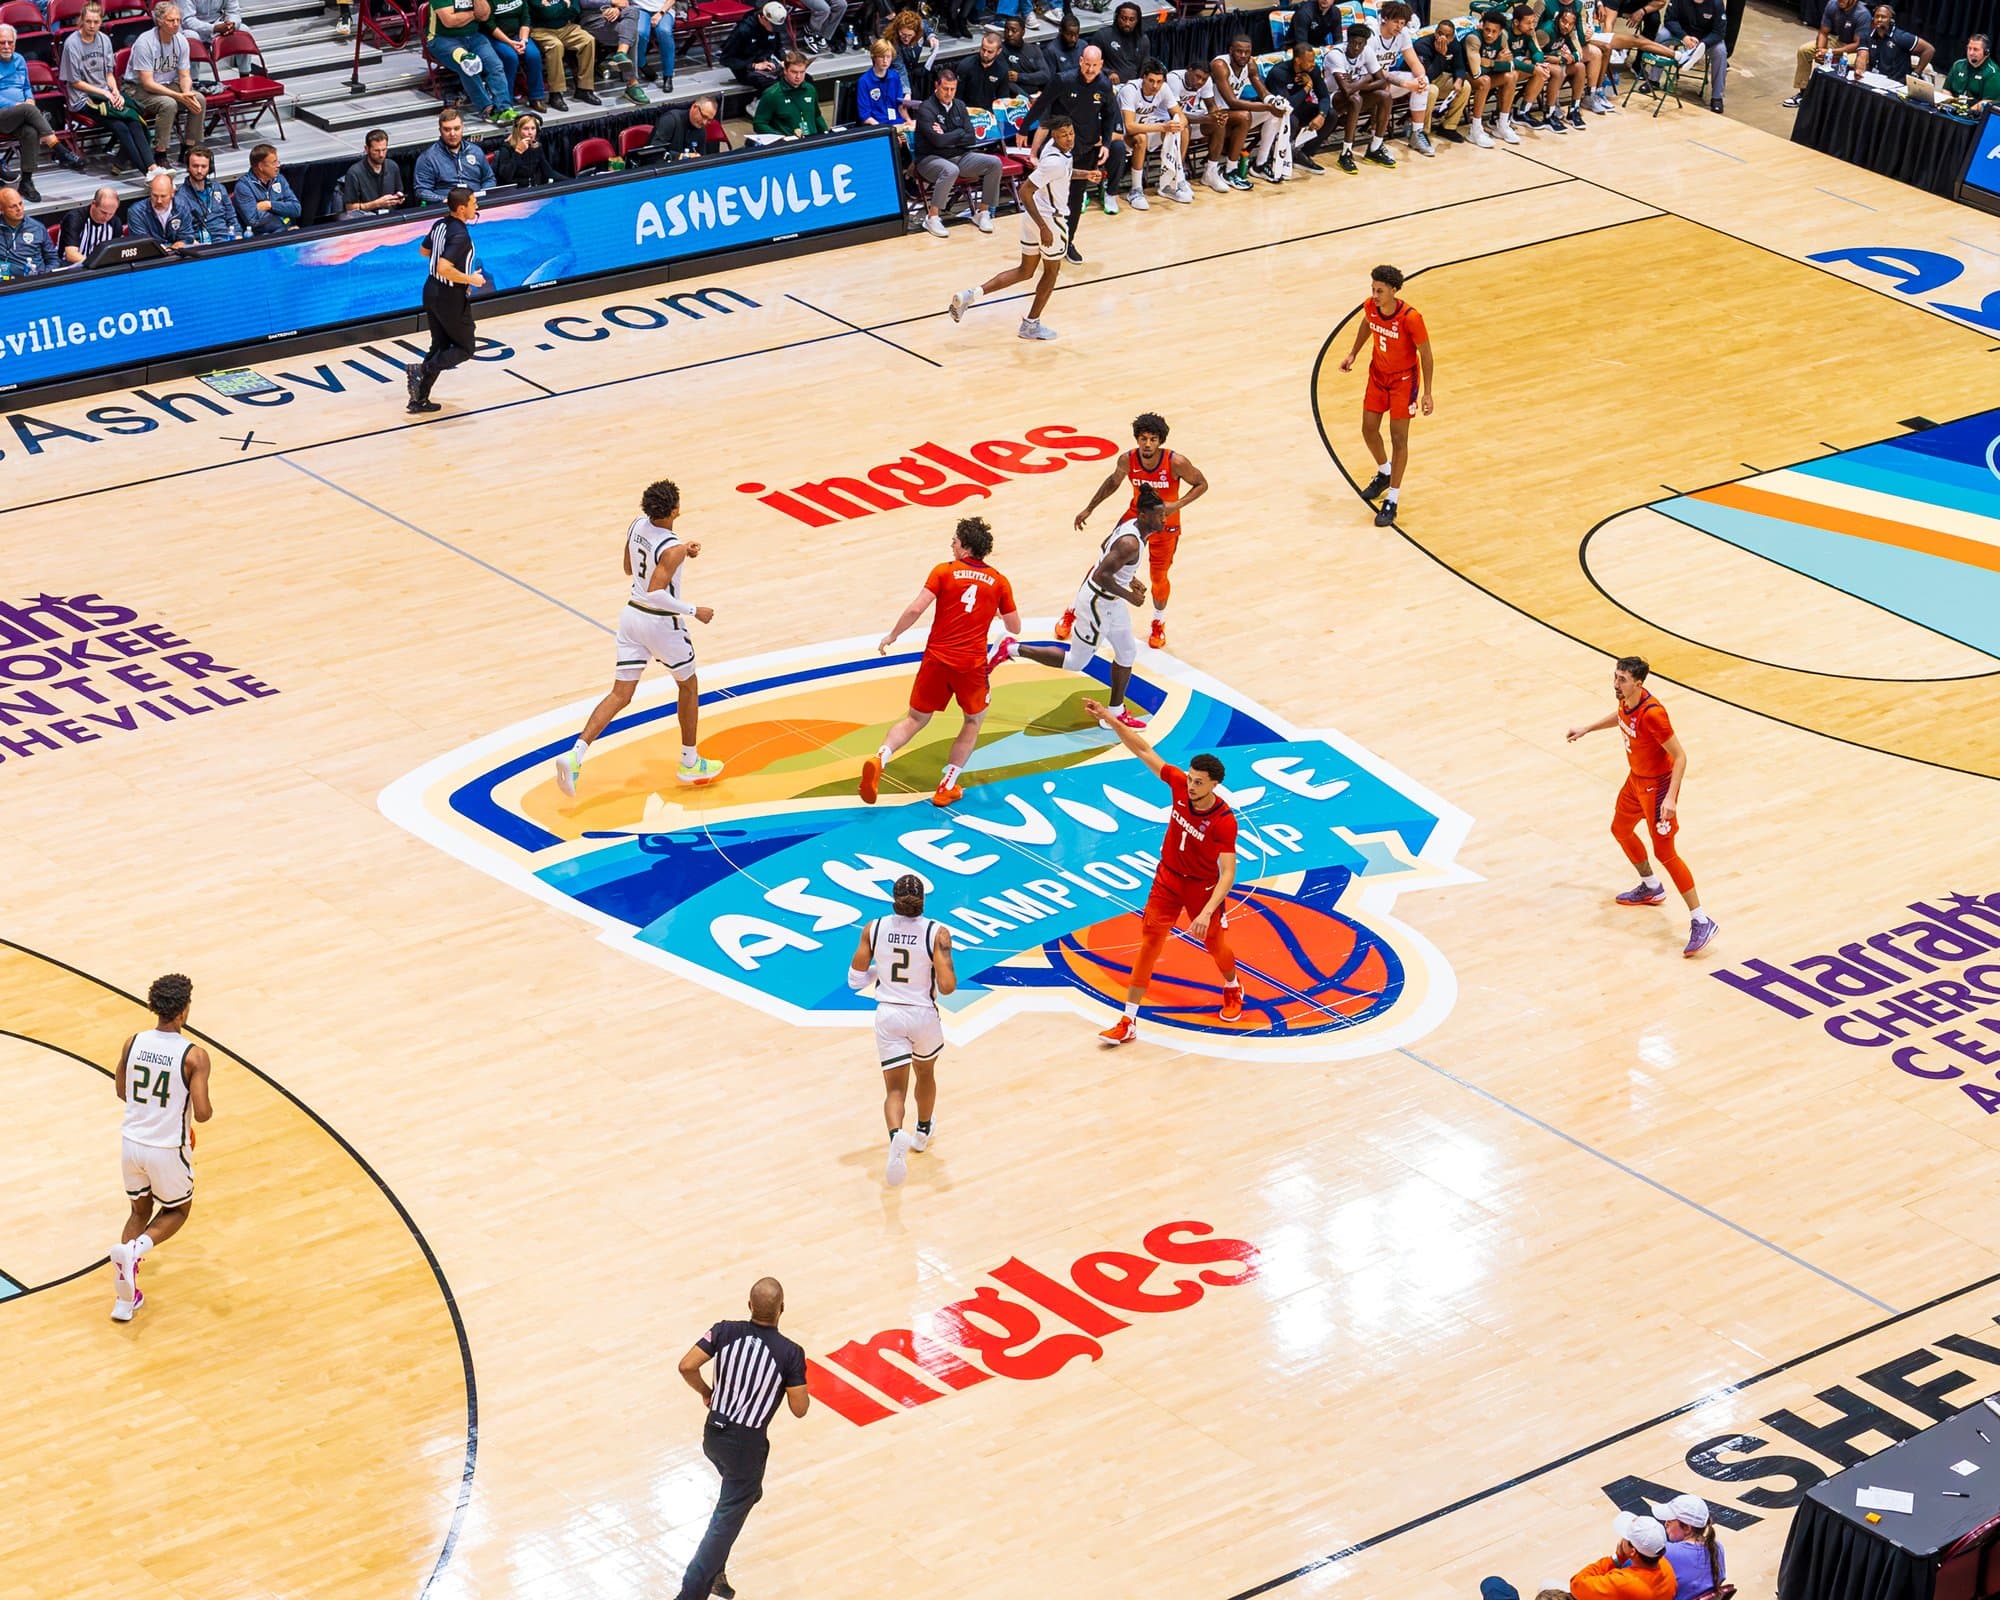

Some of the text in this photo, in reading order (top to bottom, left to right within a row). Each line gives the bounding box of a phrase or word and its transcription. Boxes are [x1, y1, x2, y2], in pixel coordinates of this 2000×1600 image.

[635, 163, 857, 246] ASHEVILLE
[121, 247, 138, 258] POSS
[0, 304, 174, 360] ville.com
[1369, 321, 1399, 340] CLEMSON
[1379, 335, 1387, 353] 5
[0, 286, 763, 463] Ashville.com
[735, 424, 1120, 528] ingles
[637, 548, 647, 580] 3
[960, 583, 978, 614] 4
[0, 623, 192, 689] OKEE
[0, 674, 281, 764] HEVILLE
[1172, 809, 1205, 841] CLEMSON
[1179, 830, 1188, 851] 1
[888, 932, 918, 945] ORTIZ
[891, 947, 909, 983] 2
[137, 1050, 173, 1067] JOHNSON
[133, 1064, 170, 1108] 24
